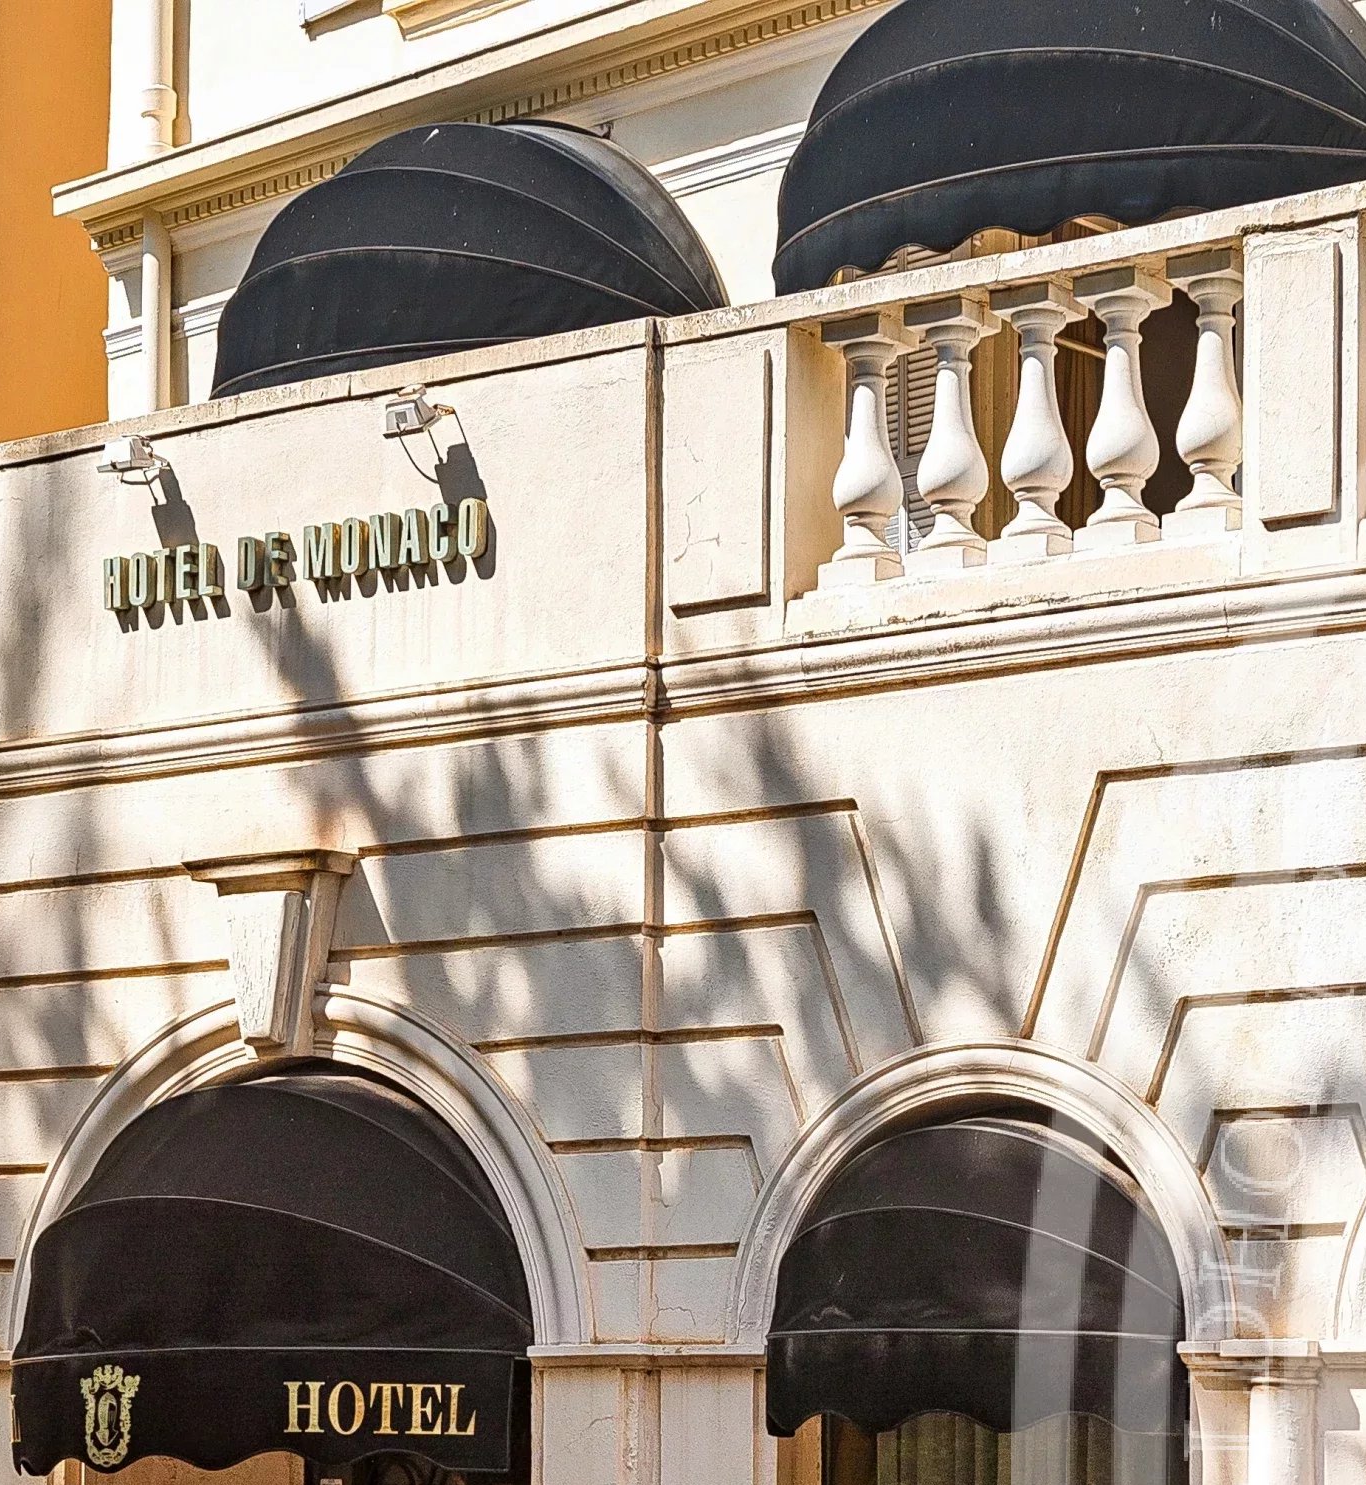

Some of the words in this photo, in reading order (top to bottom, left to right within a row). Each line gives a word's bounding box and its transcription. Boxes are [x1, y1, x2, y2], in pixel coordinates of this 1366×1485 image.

[103, 542, 224, 612] HOTEL
[238, 531, 291, 591] DE
[303, 497, 488, 581] MONACO
[283, 1381, 476, 1436] HOTEL
